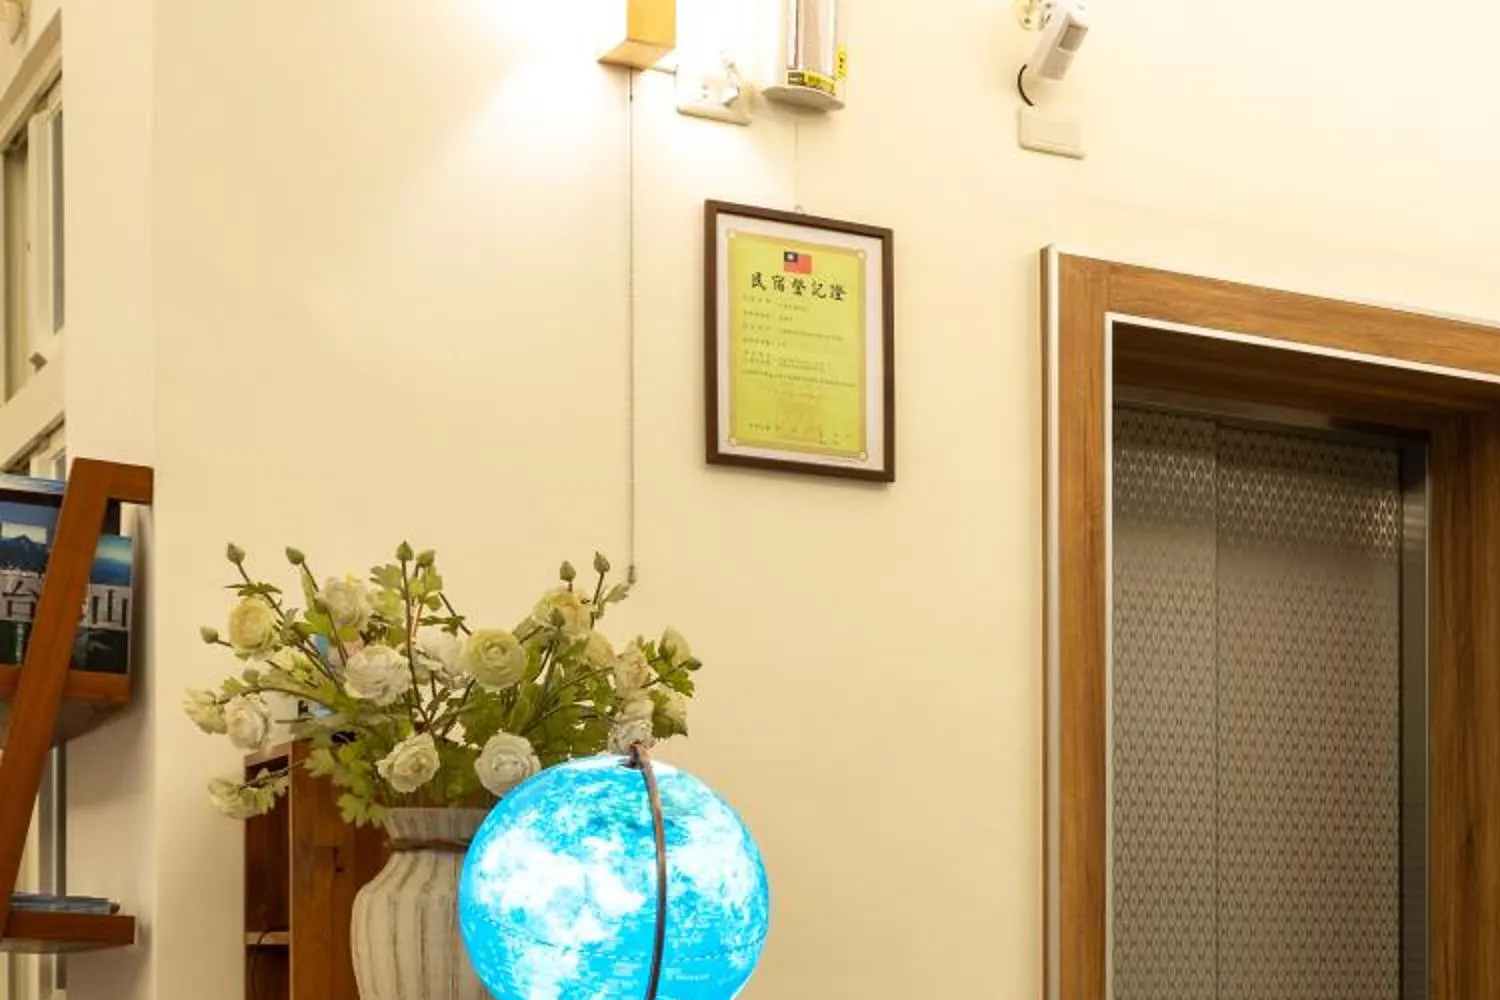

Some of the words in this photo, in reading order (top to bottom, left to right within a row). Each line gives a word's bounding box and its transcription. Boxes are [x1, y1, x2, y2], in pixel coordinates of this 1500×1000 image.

[751, 271, 847, 301] 民宿登記證
